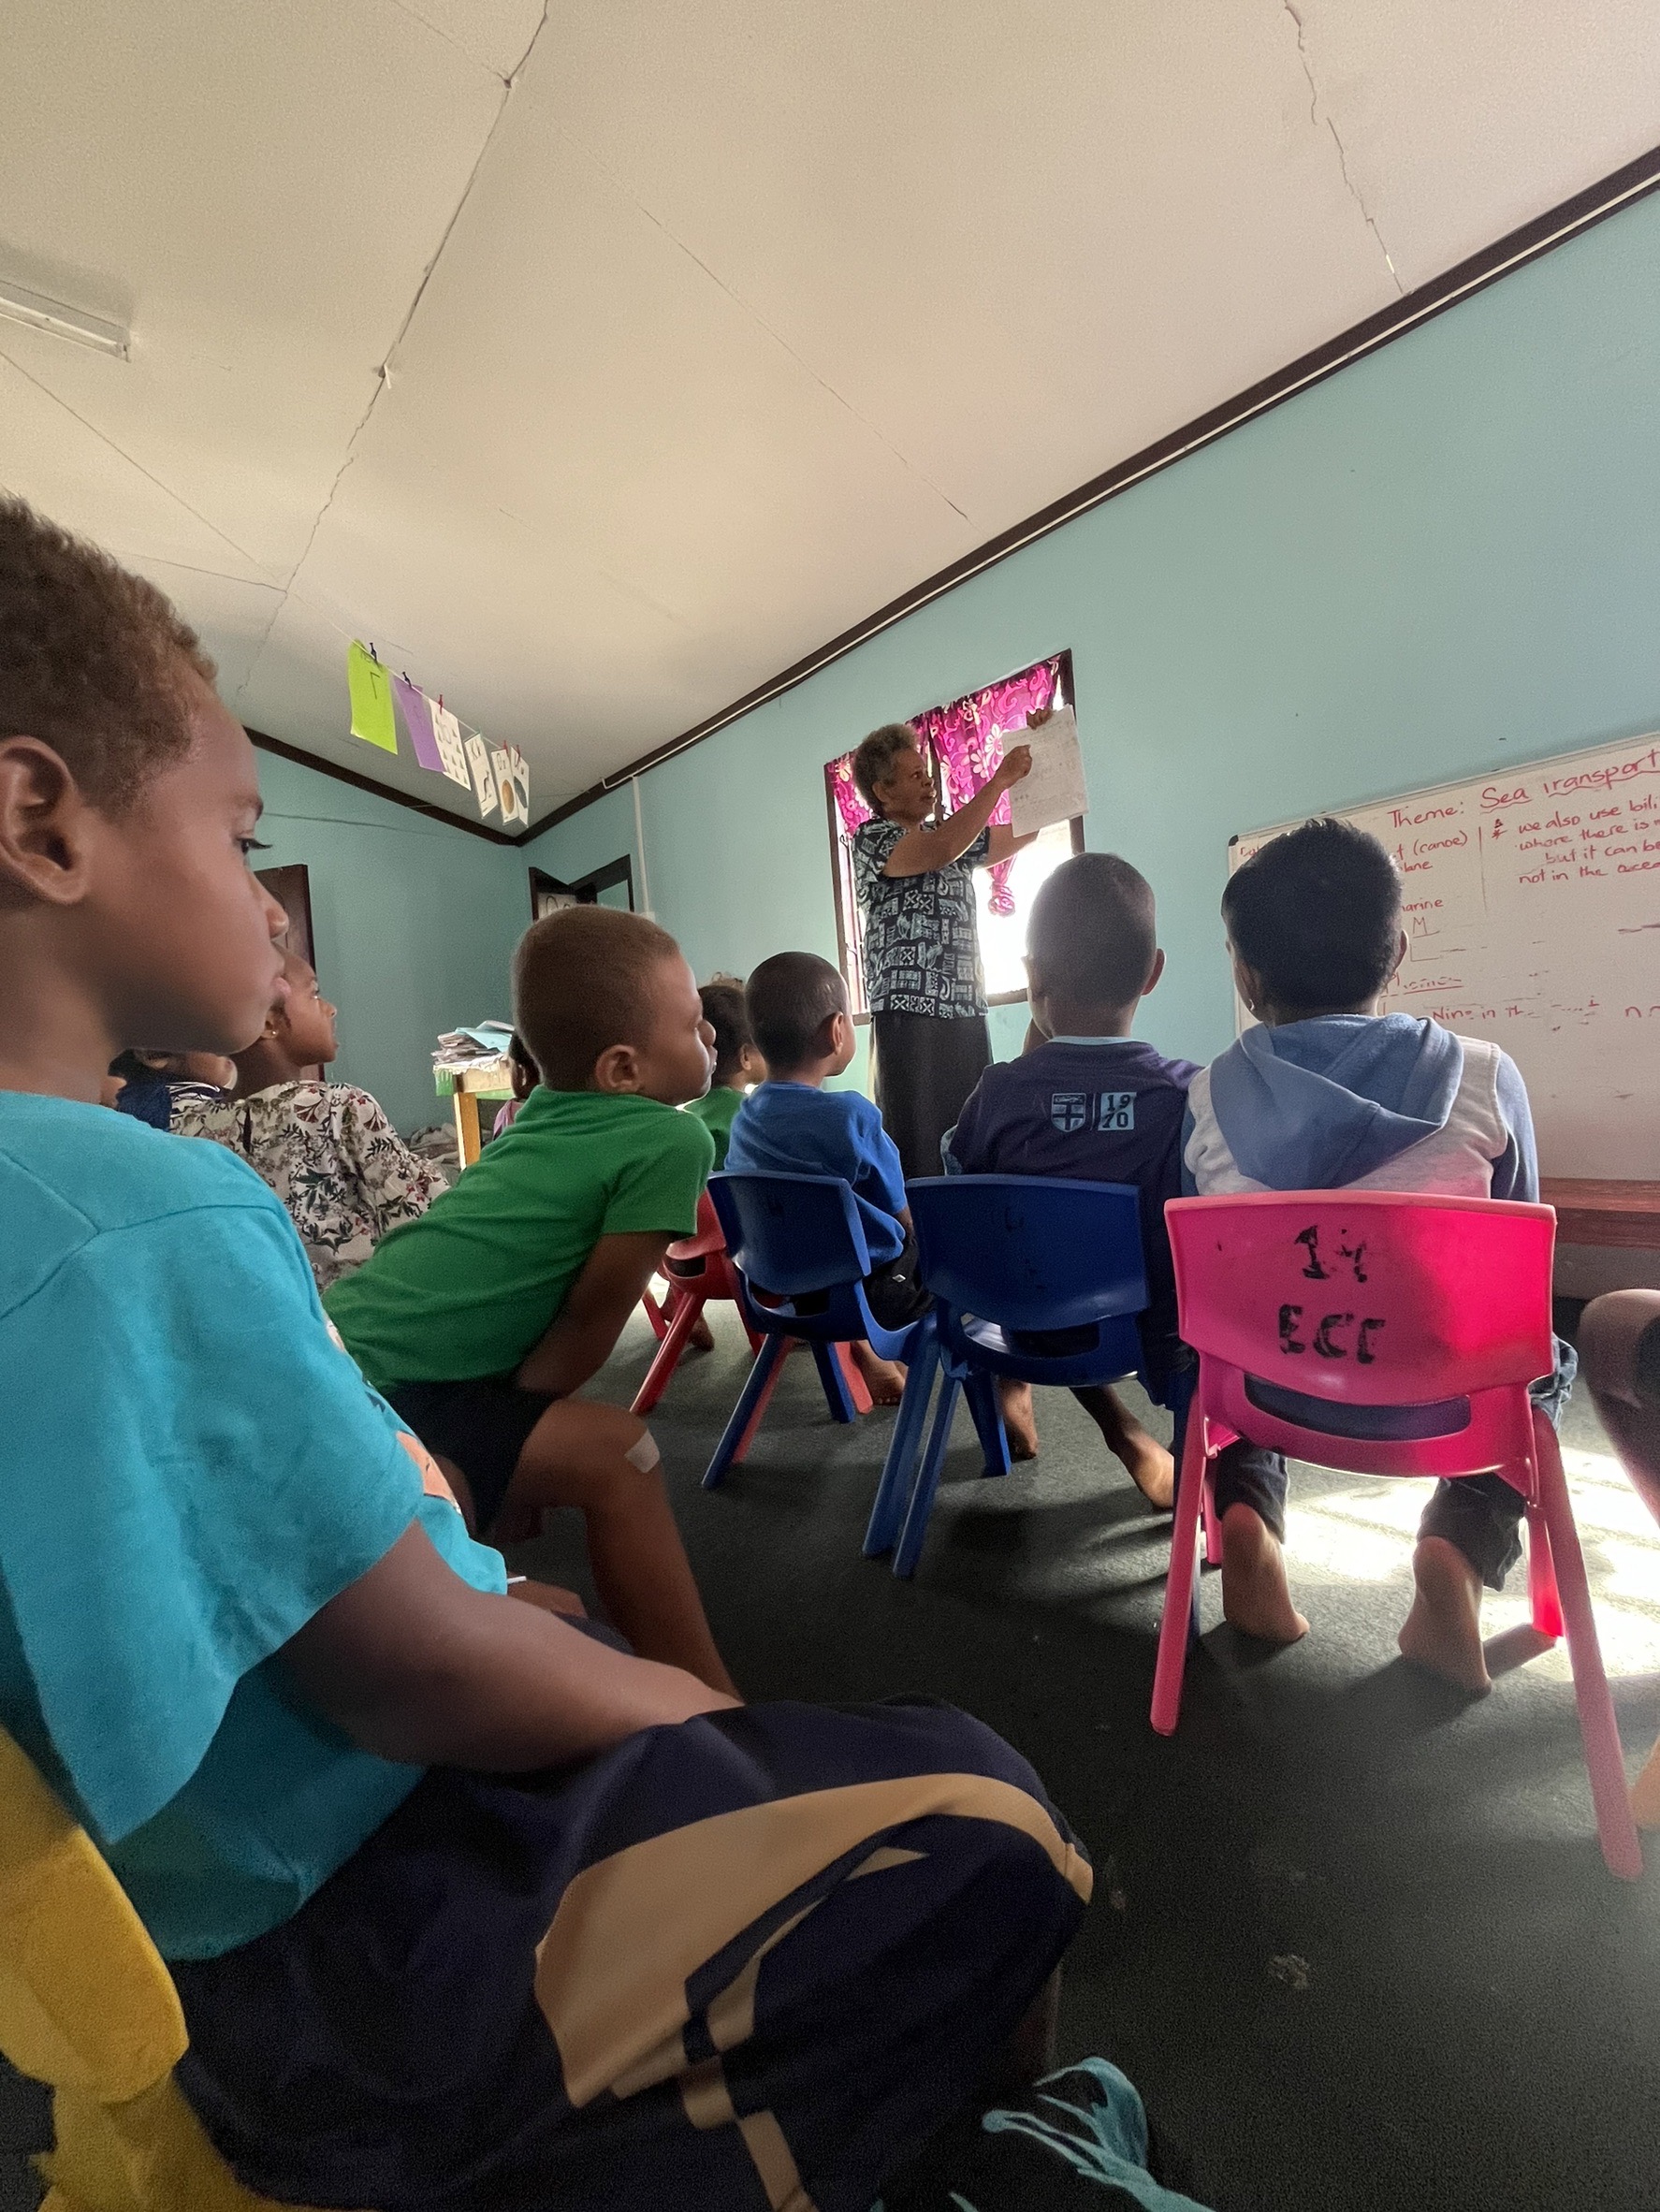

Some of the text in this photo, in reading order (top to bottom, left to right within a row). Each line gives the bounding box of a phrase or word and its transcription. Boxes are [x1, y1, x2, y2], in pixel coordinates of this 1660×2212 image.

[1387, 802, 1464, 829] Theme:
[1480, 787, 1529, 809] Sea
[1518, 822, 1542, 835] we
[1545, 810, 1580, 829] also
[1589, 807, 1623, 821] use
[1413, 830, 1468, 855] (canoe)
[1519, 837, 1574, 851] where
[1579, 824, 1629, 841] there
[1634, 818, 1650, 831] is
[1544, 848, 1578, 864] but
[1583, 844, 1597, 860] it
[1604, 846, 1638, 857] can
[1399, 861, 1434, 873] lane
[1518, 867, 1547, 884] not
[1551, 869, 1569, 881] in
[1579, 865, 1609, 878] the
[1402, 897, 1444, 912] arine
[1106, 1094, 1131, 1112] 19
[1101, 1111, 1129, 1128] 70
